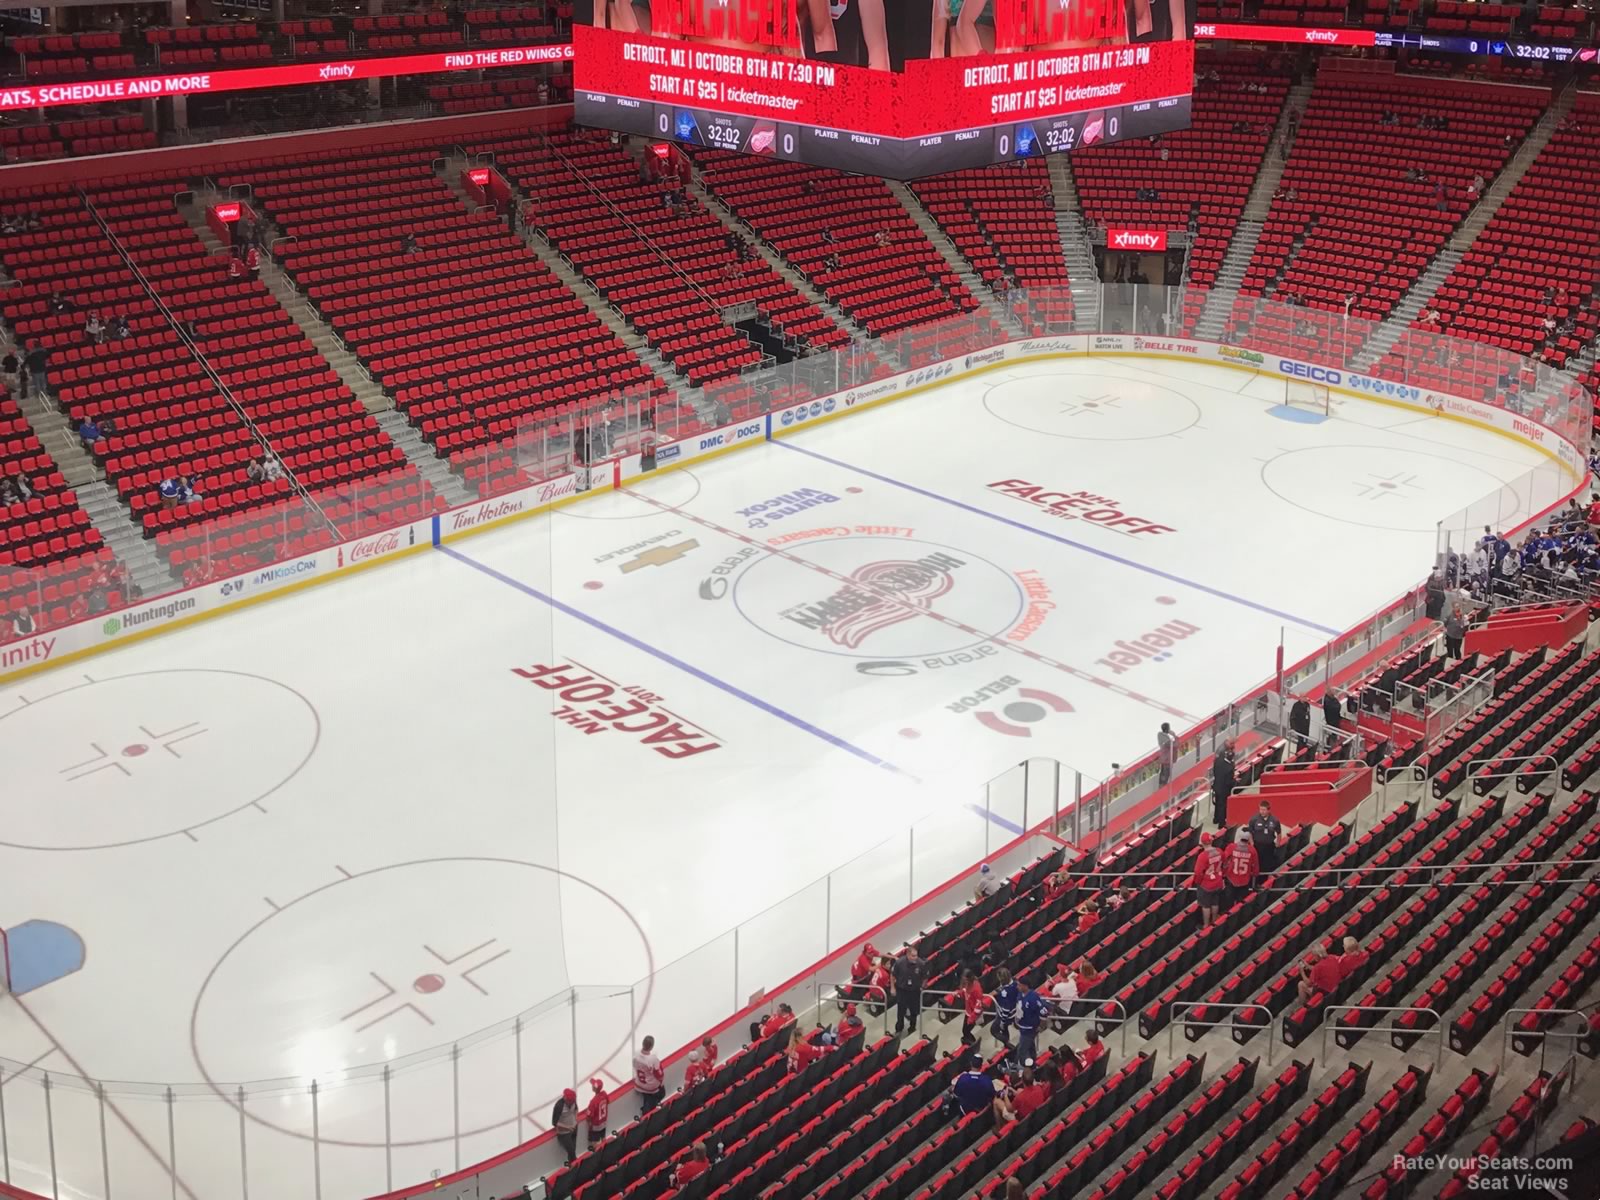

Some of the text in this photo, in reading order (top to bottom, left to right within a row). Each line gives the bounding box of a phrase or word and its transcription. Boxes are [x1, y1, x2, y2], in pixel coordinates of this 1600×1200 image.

[1305, 30, 1338, 43] xfinity
[1470, 41, 1478, 52] 0
[1516, 45, 1550, 59] 32:02
[1552, 46, 1573, 55] PERIOD
[445, 54, 474, 67] FIND
[475, 52, 498, 64] THE
[500, 50, 524, 62] RED
[526, 48, 562, 60] WINGS
[623, 43, 668, 67] DETROIT,
[671, 49, 686, 67] MI
[696, 52, 743, 75] OCTOBER
[746, 58, 768, 78] 8TH
[771, 61, 785, 80] AT
[787, 63, 813, 83] 7:30
[816, 66, 835, 86] PM
[319, 64, 356, 79] xfinity
[964, 64, 1011, 88] DETROIT,
[1014, 62, 1028, 81] MI
[1037, 55, 1080, 78] OCTOBER
[1082, 53, 1100, 72] 8TH
[1102, 51, 1113, 70] AT
[1115, 48, 1134, 68] 7:30
[1136, 47, 1150, 65] PM
[39, 82, 125, 103] SCHEDULE
[128, 79, 162, 94] AND
[165, 75, 210, 91] MORE
[587, 94, 606, 103] PLAYER
[650, 74, 680, 93] START
[683, 78, 695, 96] AT
[698, 80, 718, 101] $25
[727, 86, 800, 110] ticketmaster
[991, 92, 1022, 114] START
[1024, 90, 1036, 109] AT
[1038, 87, 1056, 108] $25
[1064, 82, 1123, 102] ticketmaster
[617, 98, 640, 108] PENALTY
[1133, 103, 1150, 112] PLAYER
[1158, 98, 1178, 108] PENALTY
[659, 113, 669, 132] 0
[715, 118, 732, 126] SHOTS
[1053, 120, 1068, 129] SHOTS
[1109, 117, 1118, 136] 0
[708, 125, 740, 144] 32:02
[784, 133, 794, 154] 0
[815, 129, 838, 140] PLAYER
[851, 134, 881, 146] PENALTY
[920, 136, 942, 147] PLAYER
[955, 130, 980, 141] PENALTY
[1046, 127, 1075, 146] 32:02
[1000, 135, 1009, 155] 0
[1114, 231, 1159, 248] xfinity
[1144, 341, 1198, 353] BELLE TIRE
[1279, 359, 1341, 385] GEICO
[700, 424, 760, 450] DMC DOCS
[1513, 418, 1545, 442] meijer
[734, 487, 823, 518] Wilcox
[764, 492, 842, 521] Burns
[1071, 491, 1121, 508] NHL
[452, 499, 523, 530] Tim Hortons
[1042, 508, 1078, 520] 2017
[767, 526, 851, 546] Caesars
[593, 529, 683, 564] CHEVROLET
[712, 547, 760, 575] arena
[122, 597, 196, 628] Huntington
[922, 644, 999, 669] arena
[1093, 619, 1202, 675] meijer
[621, 685, 665, 704] 2017
[945, 674, 1022, 714] BELFOR
[551, 704, 609, 735] NHL
[1232, 858, 1250, 875] 15
